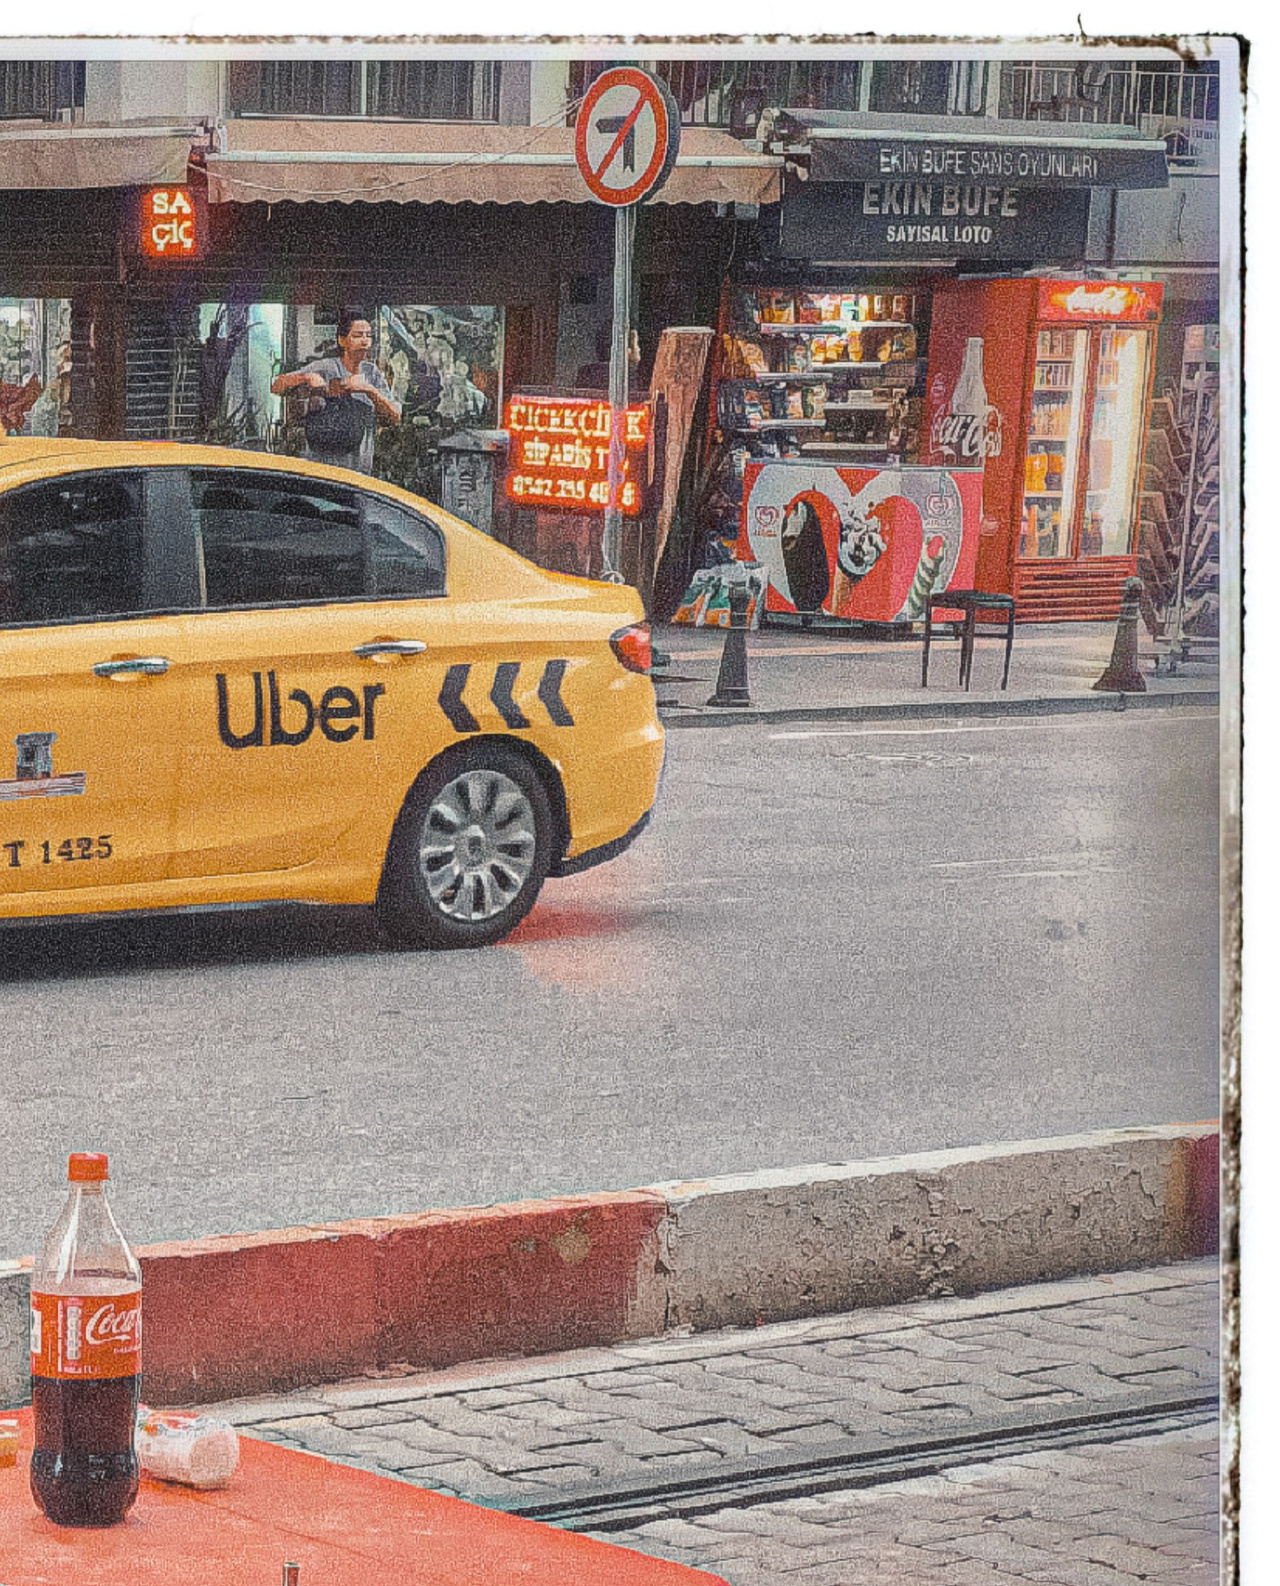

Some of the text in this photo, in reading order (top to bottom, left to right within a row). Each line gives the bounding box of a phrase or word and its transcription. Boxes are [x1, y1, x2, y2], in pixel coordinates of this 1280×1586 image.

[152, 191, 192, 215] SA
[886, 225, 993, 243] SAYISAL LOTO
[216, 670, 386, 749] Uber
[4, 841, 25, 868] T
[40, 834, 114, 865] 1425
